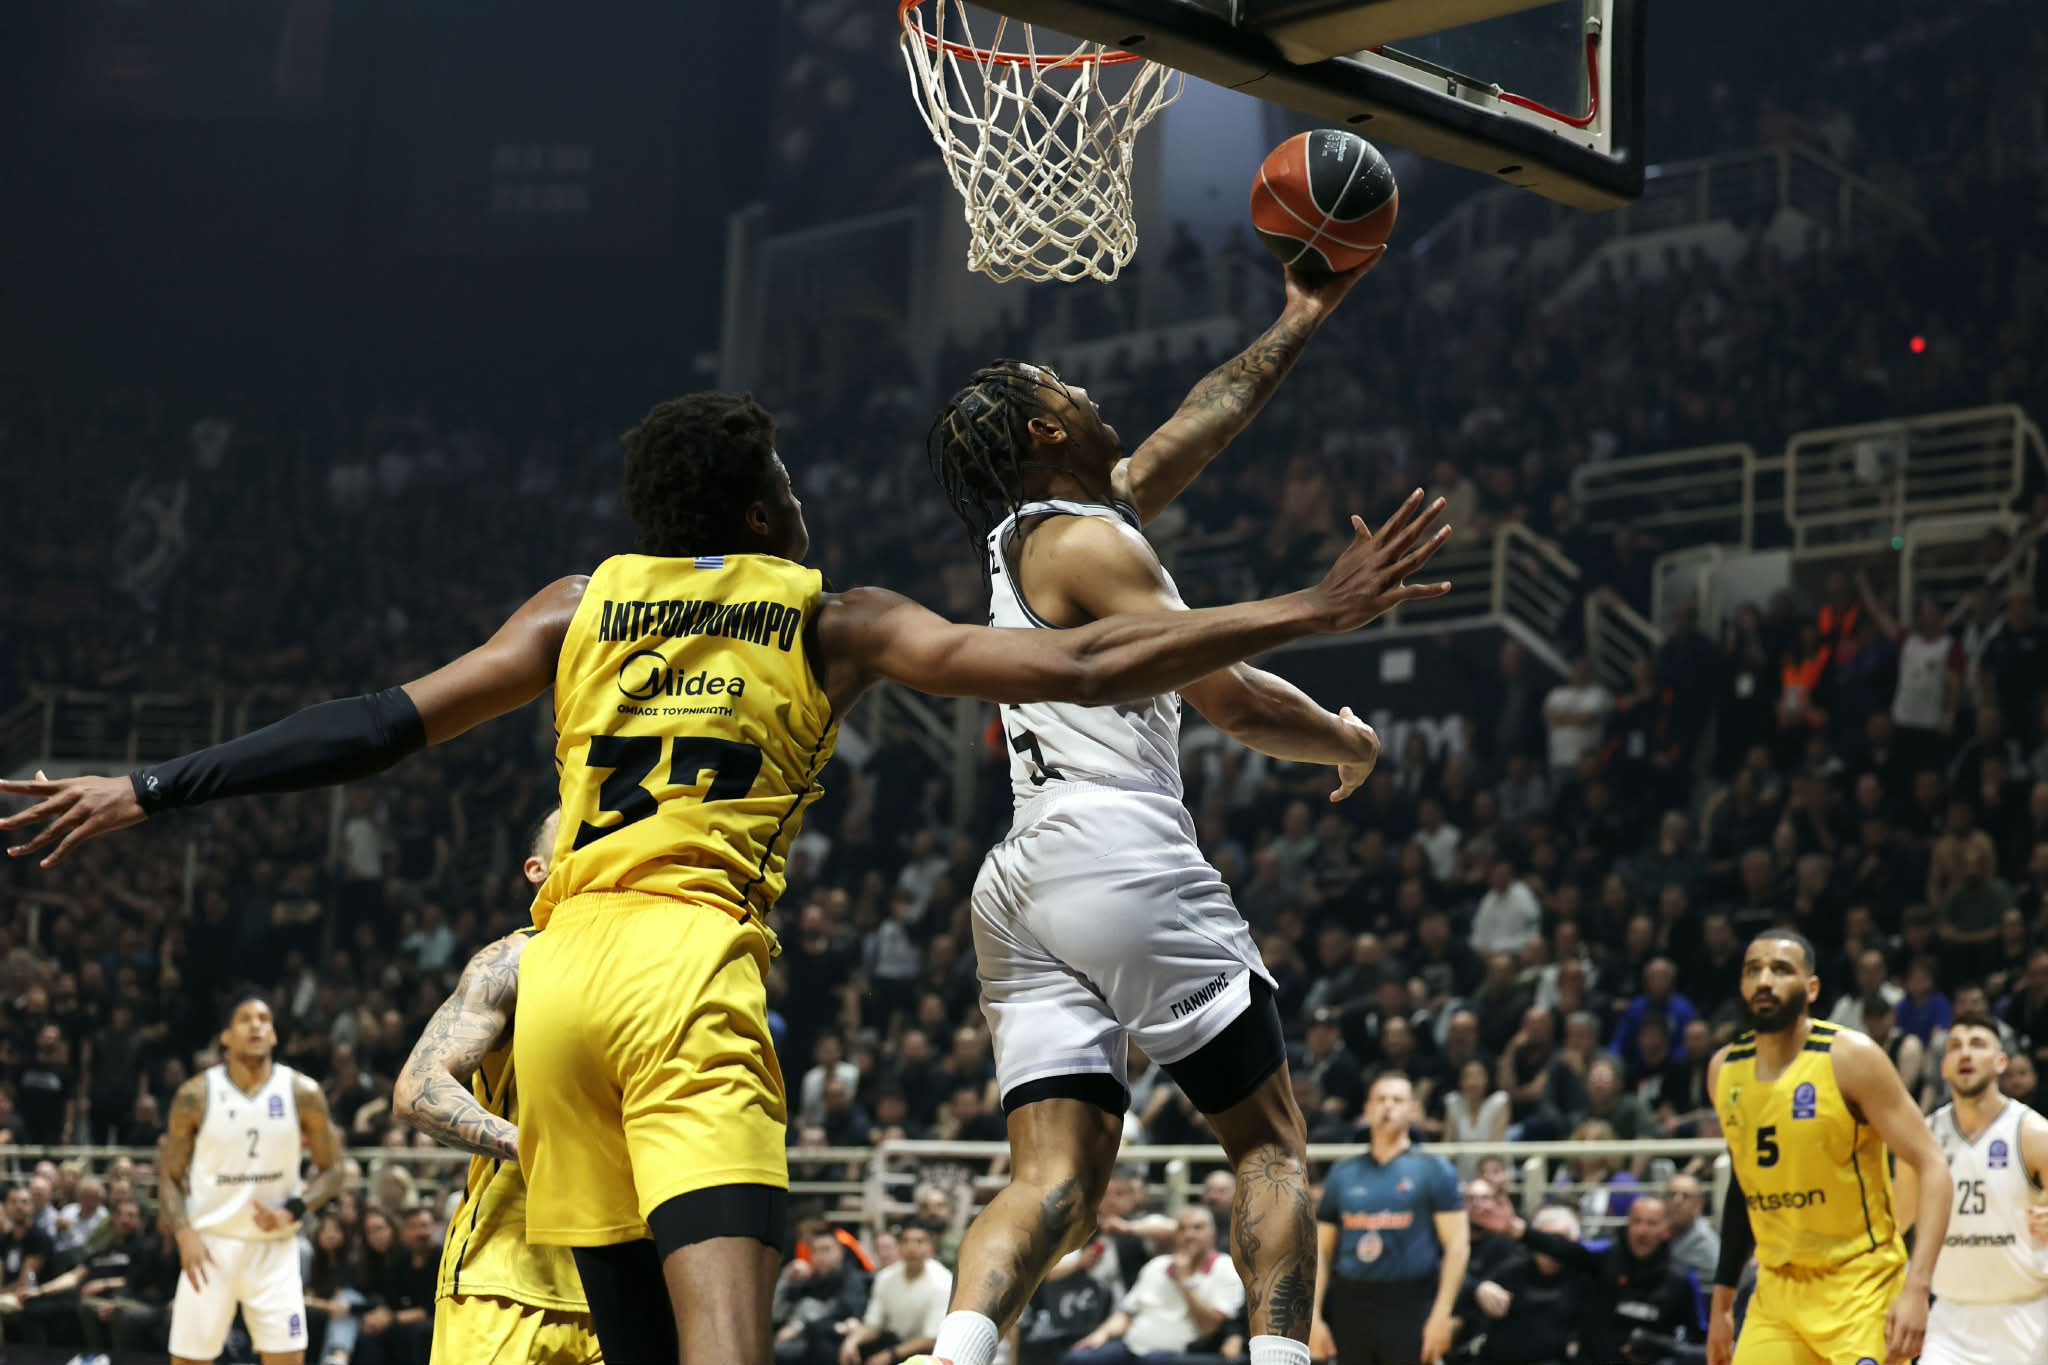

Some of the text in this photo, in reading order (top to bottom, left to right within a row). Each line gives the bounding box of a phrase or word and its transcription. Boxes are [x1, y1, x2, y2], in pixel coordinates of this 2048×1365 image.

[628, 661, 746, 700] Midea
[617, 704, 733, 717] ΟΜΙΛΟΣ ΤΟΥΡΝΙΚΙΩΤΗ
[572, 734, 763, 850] 37
[1170, 971, 1229, 1019] ΓΙΑΝΝΙΡΗΣ
[246, 1128, 260, 1159] 2
[1757, 1126, 1779, 1168] 5
[1746, 1187, 1827, 1212] etsson
[1957, 1180, 1986, 1215] 25
